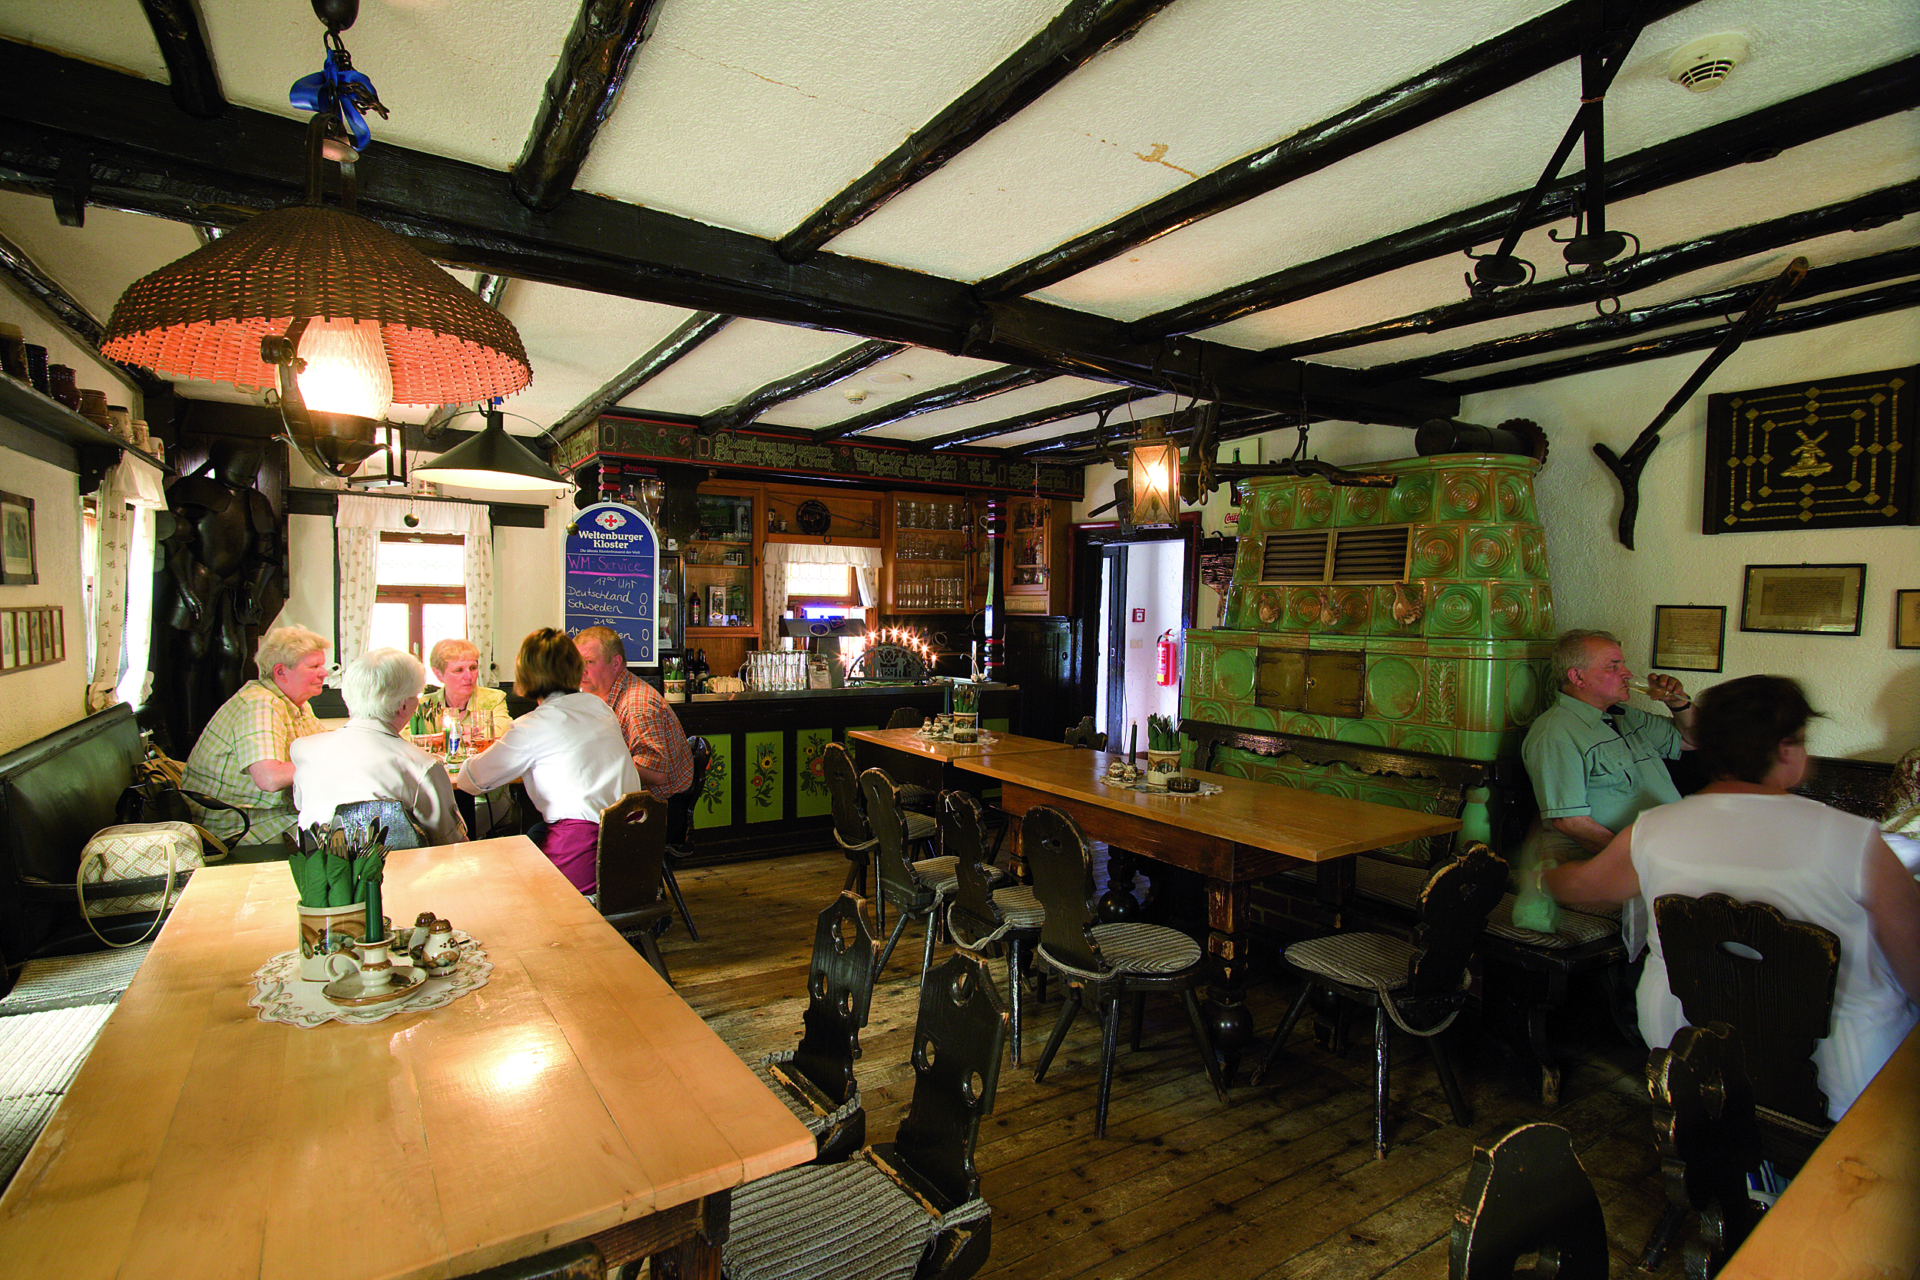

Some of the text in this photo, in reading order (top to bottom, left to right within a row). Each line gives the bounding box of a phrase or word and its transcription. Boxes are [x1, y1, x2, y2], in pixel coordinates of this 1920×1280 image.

[578, 530, 644, 543] Weltenburger
[593, 539, 629, 549] Kloster
[567, 555, 645, 572] WM-Service
[617, 579, 637, 589] Uhr
[566, 586, 634, 605] Deutschland
[567, 599, 623, 614] Schweden
